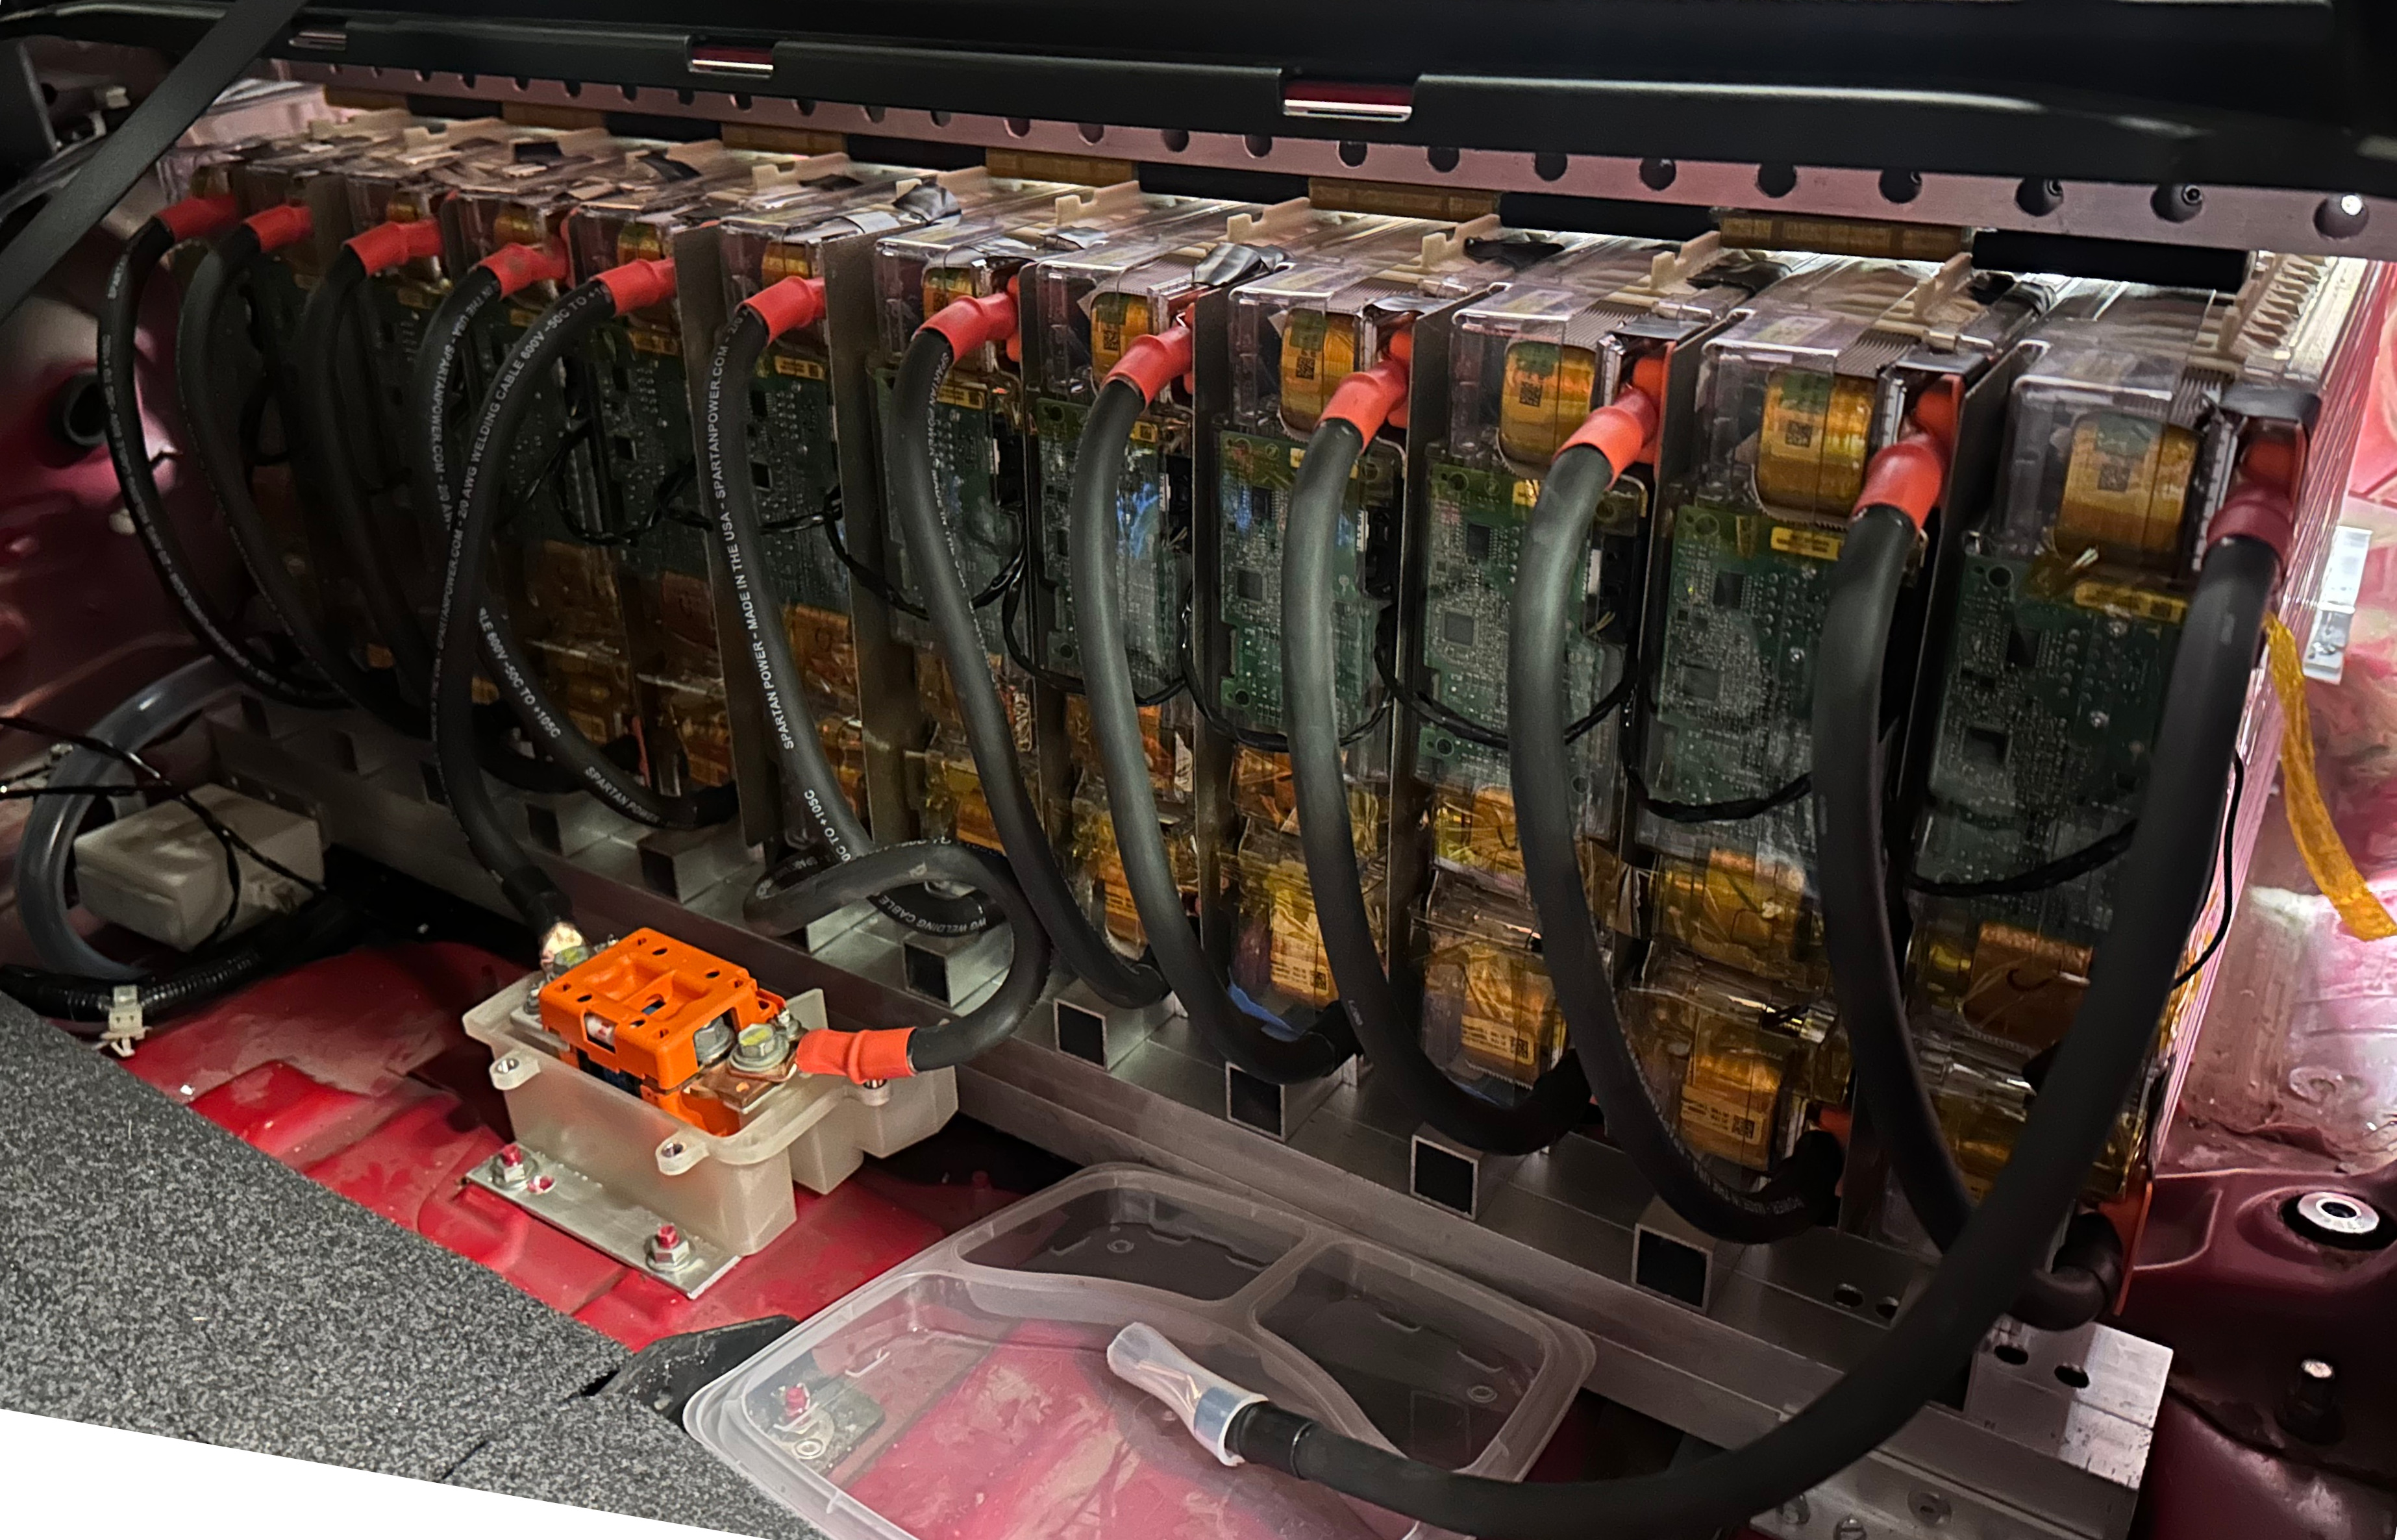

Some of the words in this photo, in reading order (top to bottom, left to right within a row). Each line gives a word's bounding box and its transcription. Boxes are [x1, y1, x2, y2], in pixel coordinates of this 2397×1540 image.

[452, 314, 469, 337] USA
[462, 466, 477, 499] AWG
[471, 403, 501, 463] WELDING
[495, 360, 525, 401] CABLE
[520, 330, 545, 359] 600V
[568, 295, 587, 310] TO
[708, 345, 729, 499] SPARTANPOWER.COM
[720, 512, 735, 541] USA
[727, 543, 743, 572] THE
[735, 575, 748, 589] IN
[739, 591, 758, 630] MADE
[752, 641, 775, 689] POWER
[488, 632, 508, 659] 600V
[504, 661, 525, 688] -50C
[520, 687, 536, 705] TO
[533, 706, 561, 738] +105C
[767, 691, 795, 750] SPARTAN
[585, 766, 630, 806] SPARTAN
[804, 789, 827, 826] +105C
[824, 827, 839, 846] TO
[878, 895, 917, 923] CABLE
